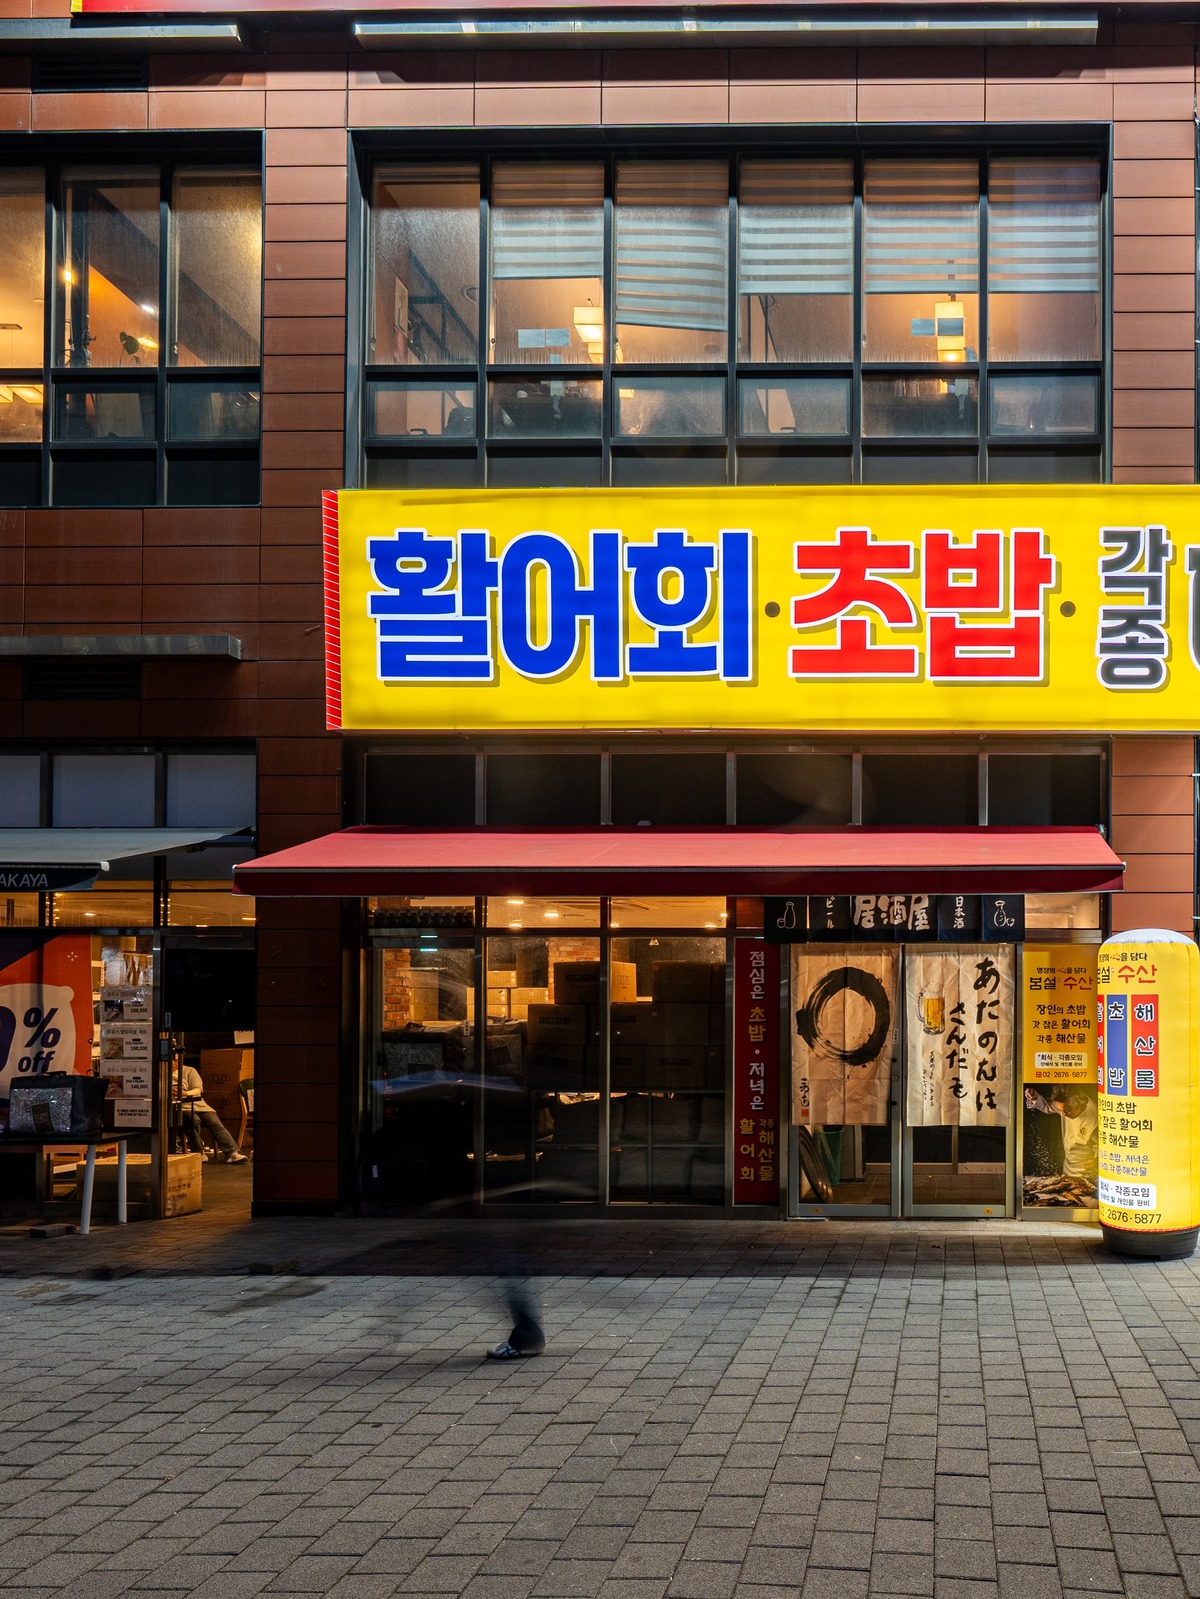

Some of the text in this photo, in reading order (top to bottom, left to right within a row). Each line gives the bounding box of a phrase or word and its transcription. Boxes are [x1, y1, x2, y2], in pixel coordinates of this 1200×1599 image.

[366, 527, 755, 682] 활어회
[788, 526, 1055, 682] 초밥
[1095, 524, 1173, 689] 각종
[826, 896, 835, 929] ビール
[854, 895, 930, 931] 居酒屋
[953, 896, 965, 929] 日本酒
[1130, 952, 1148, 961] 담다
[1118, 964, 1158, 984] 수산
[1029, 976, 1094, 990] 봄설 수산
[1036, 1004, 1086, 1015] 장인의 초밥
[748, 951, 767, 1111] 점심은 초밥 저녁은
[1032, 1019, 1091, 1030] 갓 잡은 활어회
[1037, 1033, 1087, 1044] 각종 해산물
[1108, 1002, 1125, 1088] 초밥
[1134, 1003, 1156, 1090] 해산물
[18, 1051, 55, 1073] off
[1116, 1101, 1137, 1115] 초밥
[1119, 1117, 1153, 1132] 활어회
[1109, 1133, 1139, 1149] 해산물
[739, 1118, 755, 1182] 활어회
[758, 1129, 775, 1182] 해산물
[1125, 1155, 1150, 1165] 저녁은
[1110, 1163, 1147, 1177] 각종해산물
[1115, 1185, 1150, 1198] 각종모임
[1117, 1197, 1134, 1207] 개인룸
[1137, 1198, 1150, 1207] 완비
